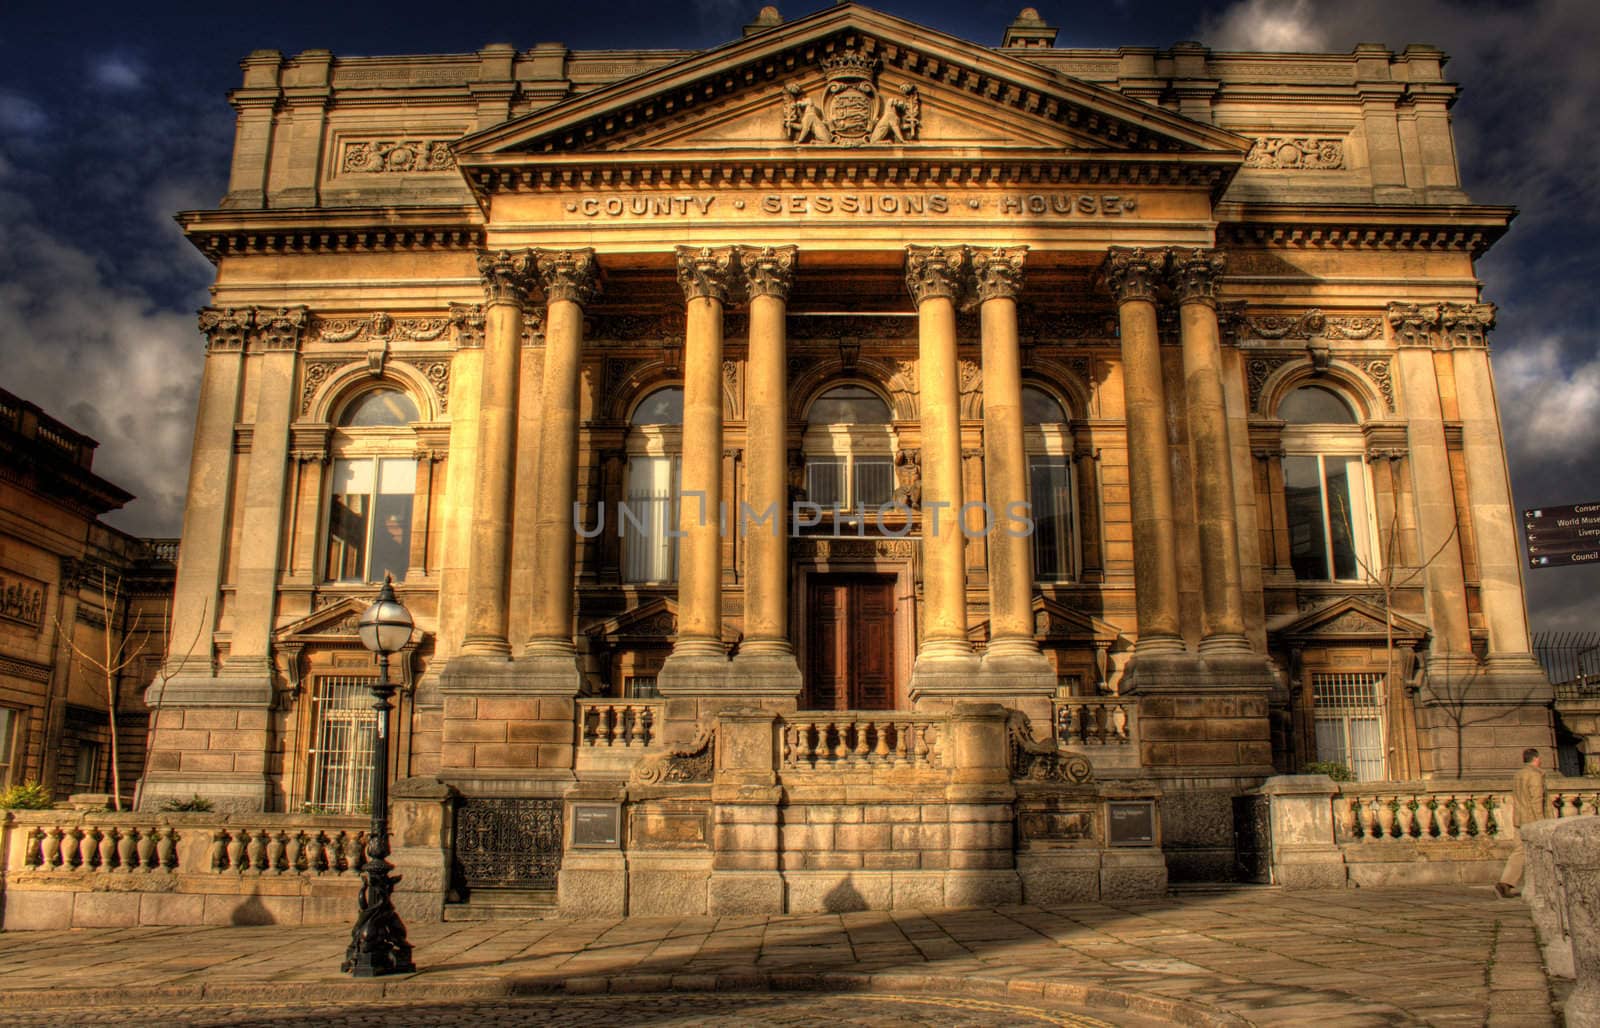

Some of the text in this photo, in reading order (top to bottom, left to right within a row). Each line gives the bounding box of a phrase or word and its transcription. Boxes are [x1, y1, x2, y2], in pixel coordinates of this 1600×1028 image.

[582, 194, 1123, 216] COUNTY SESSIONS HOUSE
[1557, 518, 1580, 526] World
[1572, 552, 1598, 560] Council
